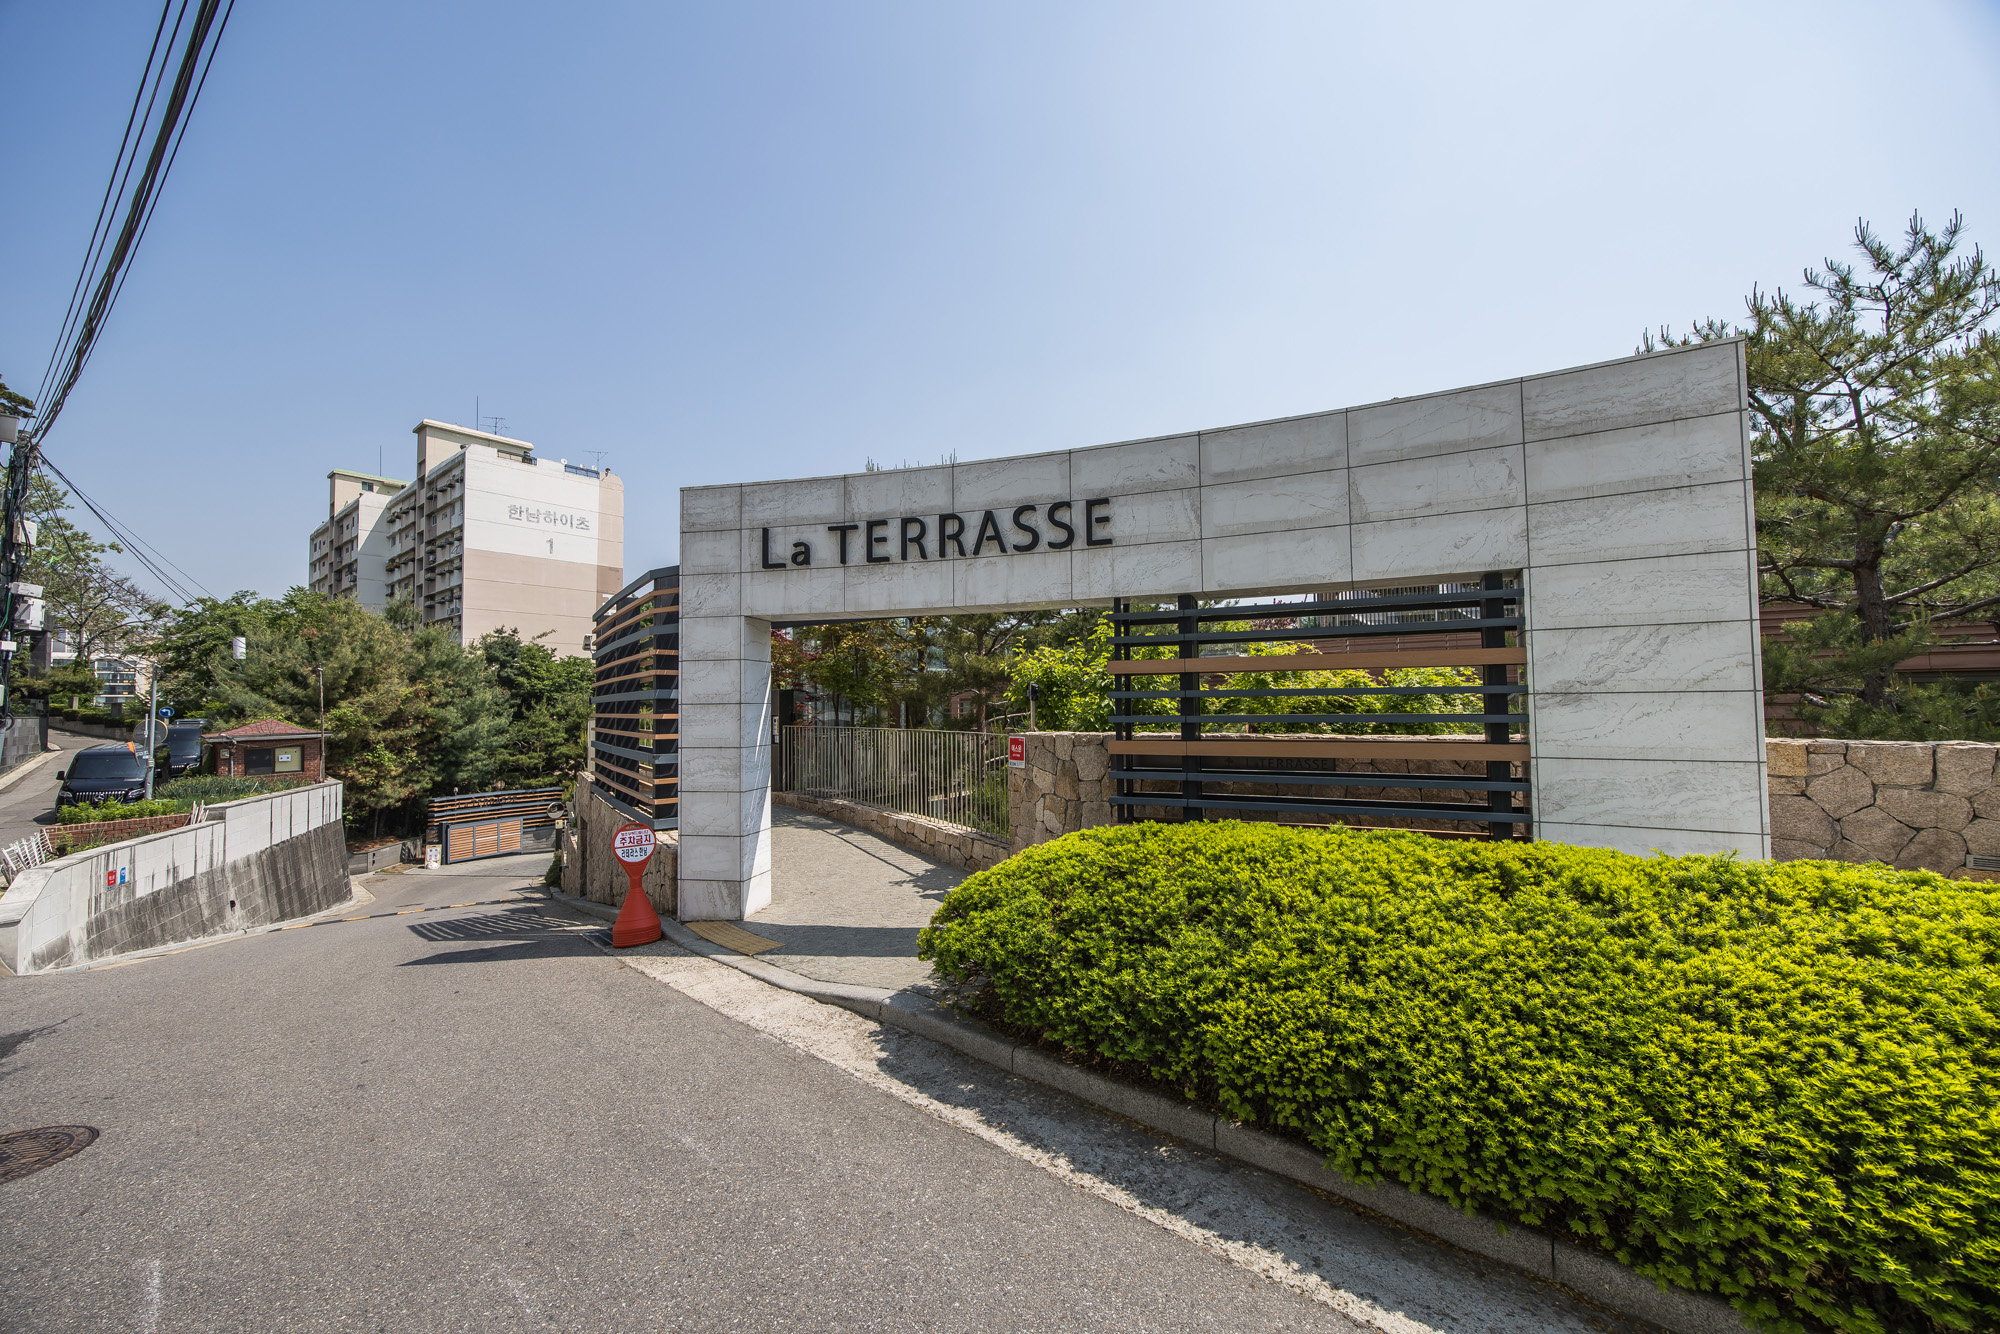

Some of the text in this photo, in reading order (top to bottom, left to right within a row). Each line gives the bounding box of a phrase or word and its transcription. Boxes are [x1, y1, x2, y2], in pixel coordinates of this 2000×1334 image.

[507, 504, 590, 531] 한남하이츠
[762, 498, 1114, 569] La TERRASSE
[546, 537, 554, 555] 1
[620, 834, 651, 846] 주차금지
